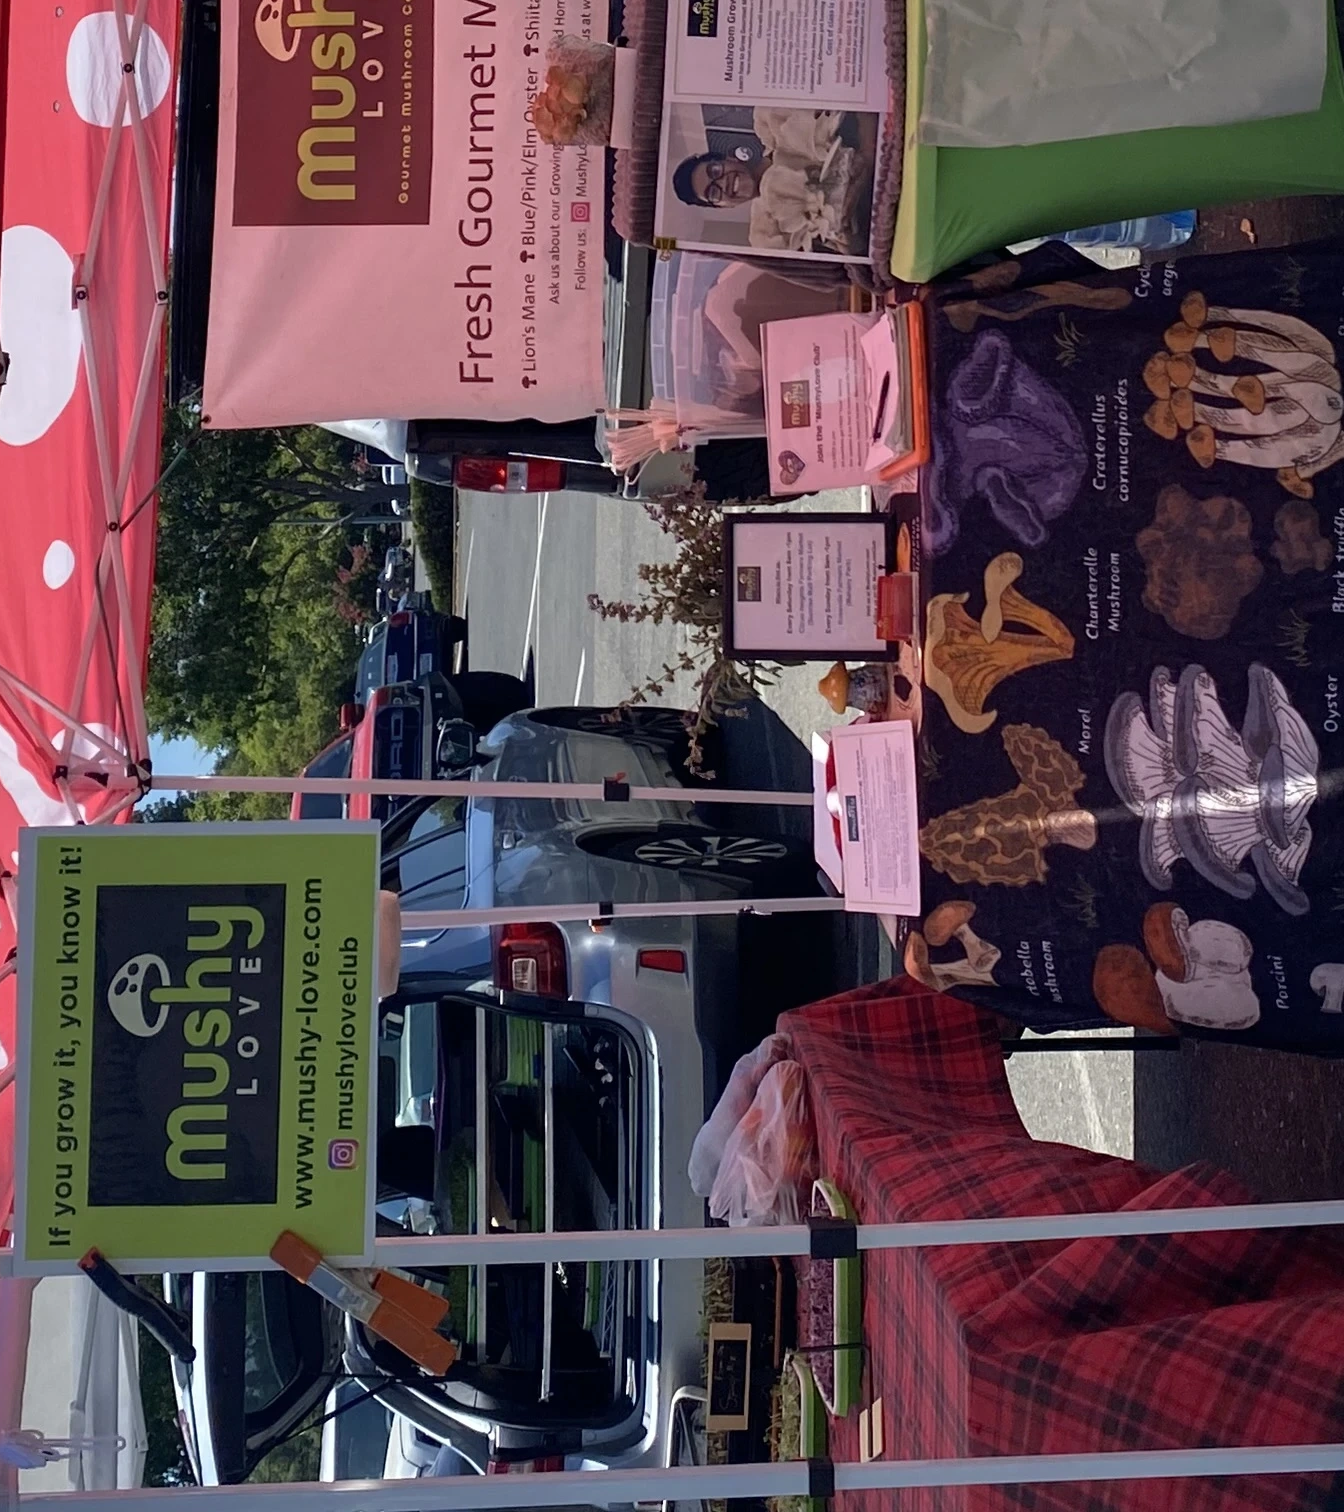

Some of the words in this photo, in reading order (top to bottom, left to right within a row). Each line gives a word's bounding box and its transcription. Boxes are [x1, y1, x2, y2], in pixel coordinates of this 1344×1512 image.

[580, 13, 591, 25] at
[400, 23, 413, 116] Mushroom
[724, 26, 736, 81] Mushroom
[398, 124, 412, 204] Gourmet
[458, 43, 497, 247] Gourmet
[549, 144, 565, 196] Growing
[520, 128, 538, 245] Blue/Pink/Elm
[550, 199, 560, 221] our
[548, 224, 560, 261] about
[577, 228, 587, 246] us:
[522, 273, 536, 320] Mane
[548, 282, 560, 304] Ask
[550, 264, 560, 279] us
[575, 250, 587, 290] Follow
[455, 264, 494, 384] Fresh
[521, 326, 537, 372] Lion's
[815, 425, 823, 442] the
[1093, 394, 1107, 490] Craterellus
[1115, 377, 1132, 502] cornucopioides
[1085, 547, 1099, 640] Chanterelle
[1107, 552, 1121, 632] Mushroom
[1324, 674, 1341, 732] Oyster
[1077, 708, 1092, 755] Morel
[59, 845, 82, 875] it!
[56, 886, 81, 964] know
[59, 975, 82, 1028] you
[1267, 955, 1290, 1009] Porcini
[236, 957, 261, 1095] LOVE
[294, 878, 323, 1210] www.mushy-love.com
[335, 936, 360, 1130] mushyloveclub
[53, 1040, 81, 1067] it,
[56, 1079, 78, 1152] grow
[54, 1164, 76, 1217] you
[48, 1227, 71, 1247] If
